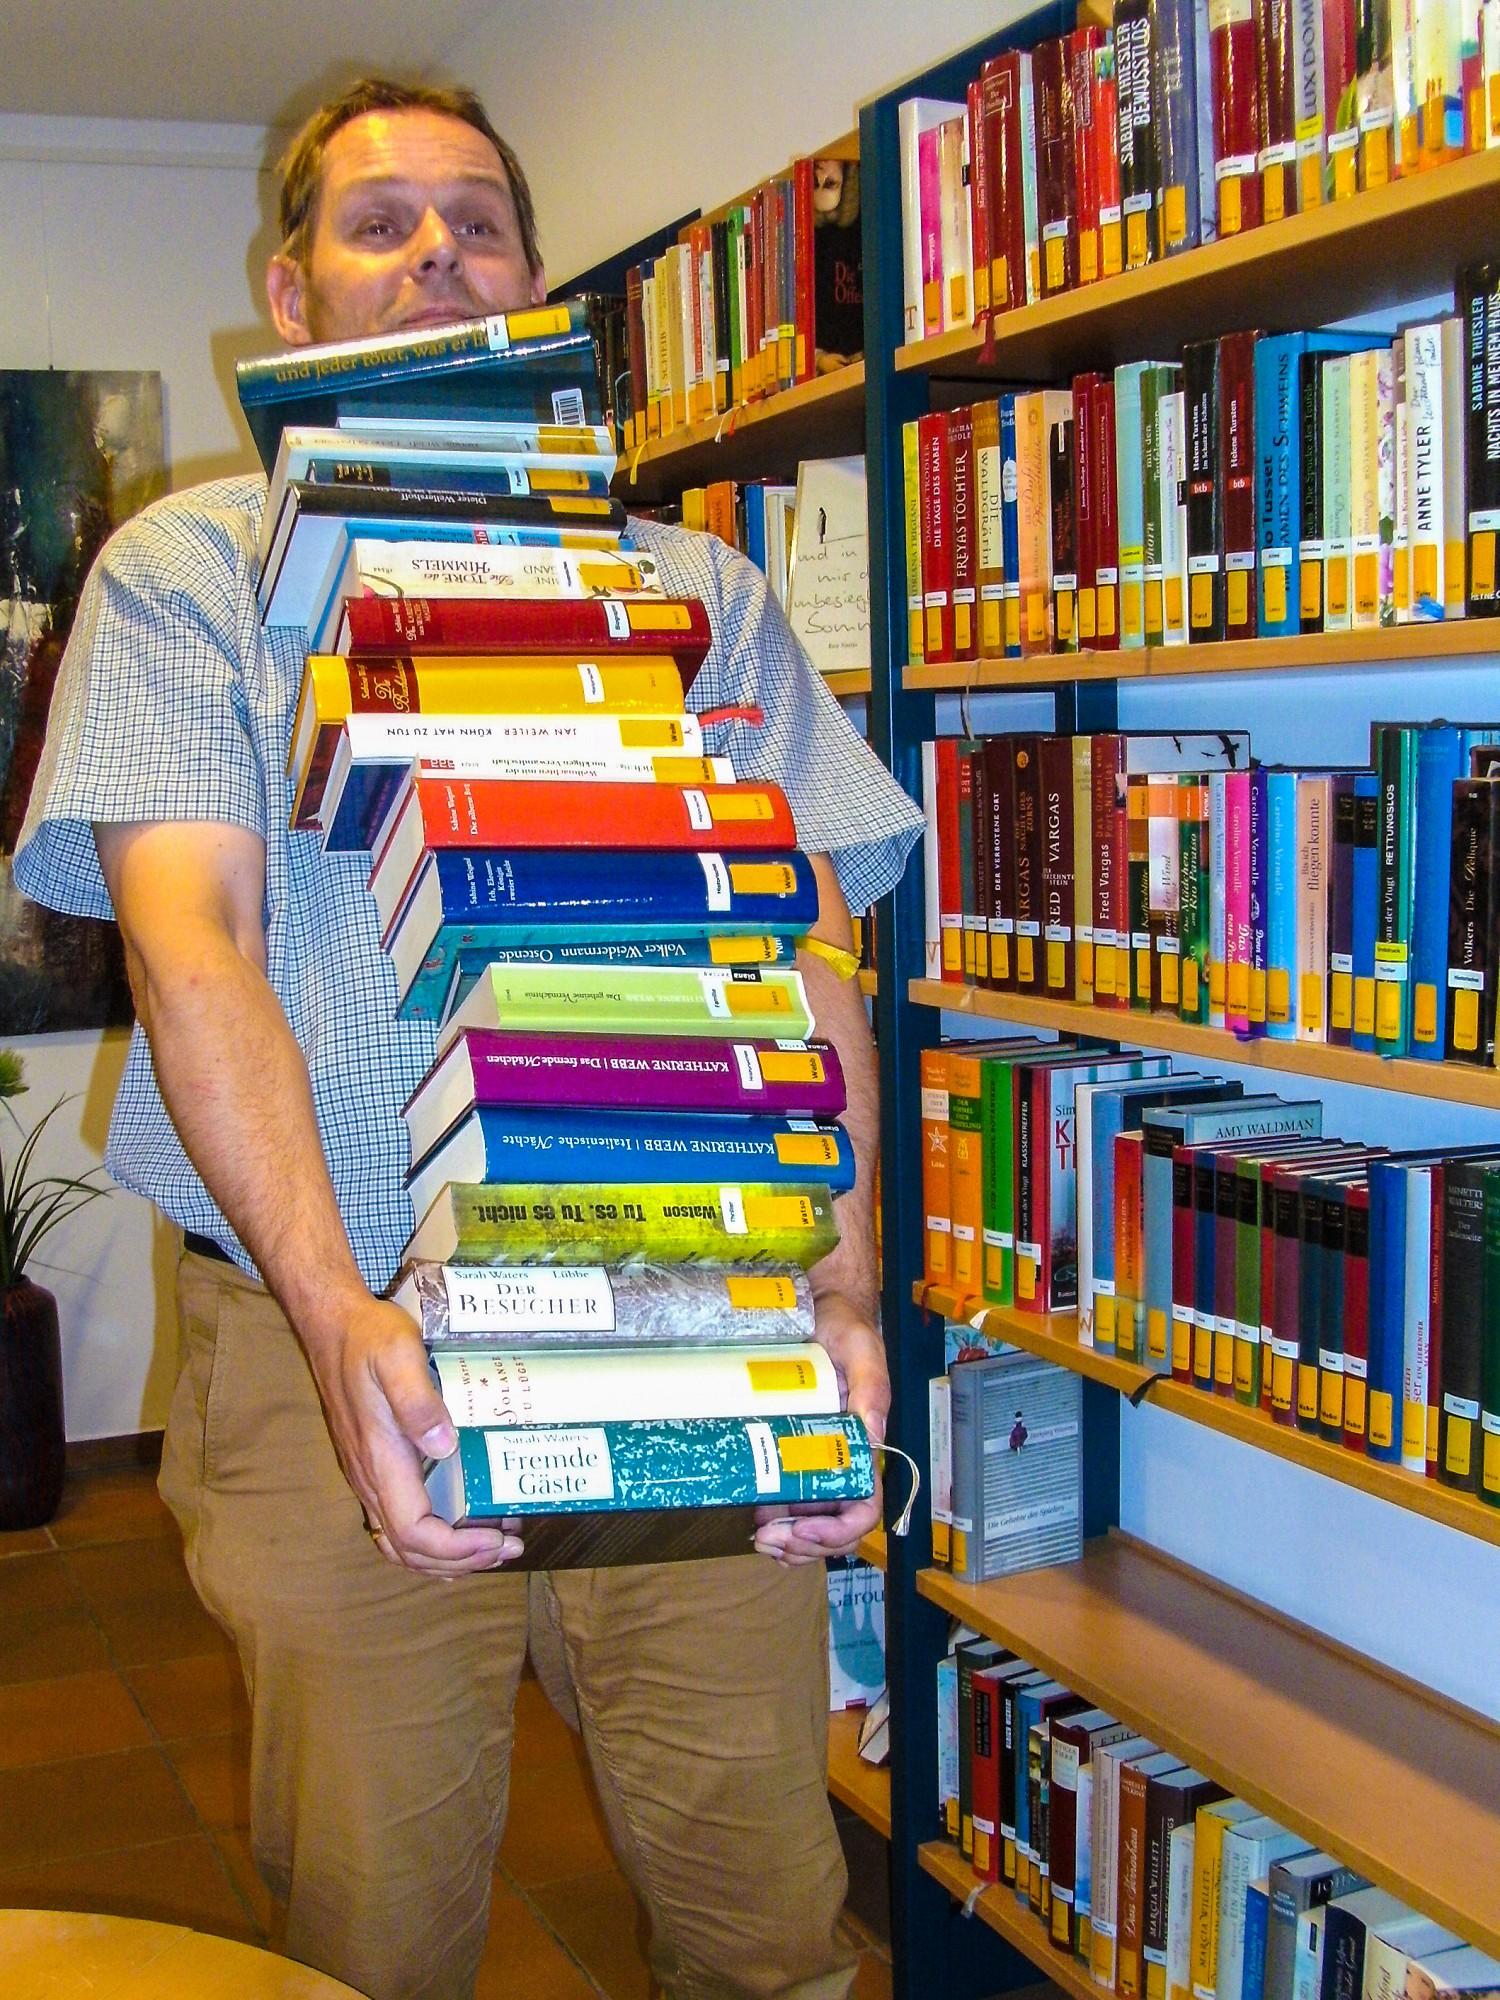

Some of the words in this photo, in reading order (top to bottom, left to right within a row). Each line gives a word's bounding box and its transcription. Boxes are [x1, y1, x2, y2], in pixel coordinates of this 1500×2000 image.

[1116, 23, 1132, 97] THIESLER
[1130, 18, 1152, 126] BEWUSSTLOS
[1305, 72, 1317, 121] LUX
[1119, 106, 1134, 165] SABINE
[1487, 294, 1500, 328] HAUS
[1472, 296, 1484, 359] THIESLER
[275, 363, 311, 383] und
[314, 358, 356, 381] jeder
[414, 339, 446, 359] was
[450, 336, 468, 352] er
[1487, 330, 1500, 386] MEINEM
[1472, 362, 1484, 411] SABINE
[1488, 389, 1500, 404] IN
[1273, 352, 1289, 447] SCHWEINS
[1229, 400, 1237, 434] Tursten
[1487, 408, 1500, 459] NACHTS
[931, 436, 940, 472] RABEN
[1145, 451, 1153, 468] mit
[1192, 440, 1200, 471] Helene
[1230, 436, 1238, 468] Helene
[1416, 425, 1431, 480] TYLER
[1278, 452, 1289, 486] DES
[932, 474, 940, 496] DES
[953, 450, 967, 523] TÖCHTER
[1263, 455, 1274, 526] Tusset
[400, 493, 455, 503] Wellershoff
[457, 495, 487, 505] Dieter
[981, 451, 990, 566] WALDGRÄFIN
[989, 494, 999, 520] DIE
[1417, 486, 1432, 531] ANNE
[910, 499, 918, 548] TRIGIANI
[933, 499, 941, 525] TAGE
[934, 528, 942, 548] DIE
[842, 545, 856, 557] in
[955, 526, 968, 577] FREYAS
[411, 559, 490, 573] HIMMELS
[442, 573, 486, 584] TORE
[387, 727, 410, 736] TUN
[412, 728, 428, 736] ZU
[433, 727, 454, 736] HAT
[460, 728, 491, 738] KÜHN
[504, 727, 549, 736] WEILER
[554, 728, 576, 736] JAN
[521, 768, 537, 776] mit
[539, 768, 597, 777] Weihnachten
[1251, 786, 1259, 835] Caroline
[1274, 796, 1282, 844] Caroline
[1309, 798, 1320, 844] konnte
[470, 822, 479, 835] Die
[1048, 793, 1060, 862] VARGAS
[1233, 806, 1242, 848] Caroline
[1386, 784, 1394, 865] RETTUNGSLOS
[1100, 844, 1111, 886] Vargas
[1464, 827, 1478, 882] Reliquie
[1233, 850, 1242, 895] Vermalle
[1309, 844, 1322, 890] fliegen
[469, 881, 477, 904] Sabine
[1385, 876, 1394, 903] Vlugt
[1465, 890, 1475, 911] Die
[1049, 892, 1061, 927] RED
[1099, 892, 1109, 919] Fred
[1384, 906, 1393, 922] der
[1238, 924, 1249, 951] Das
[1256, 929, 1264, 953] Denn
[1464, 921, 1475, 964] Volkers
[499, 949, 553, 963] Ostende
[561, 945, 643, 959] Weidermann
[644, 943, 686, 956] Volker
[733, 972, 756, 981] Diana
[524, 991, 576, 1003] Vermächtnis
[606, 993, 621, 1001] Das
[486, 1055, 541, 1067] Mädchen
[541, 1057, 578, 1068] fremde
[580, 1058, 601, 1069] Das
[610, 1058, 650, 1070] WEBB
[652, 1059, 729, 1072] KATHERINE
[1215, 1123, 1245, 1139] AMY
[1246, 1117, 1315, 1137] WALDMAN
[502, 1135, 554, 1150] Nächte
[558, 1136, 631, 1150] Italienische
[644, 1139, 687, 1151] WEBB
[690, 1140, 775, 1154] KATHERINE
[473, 1204, 527, 1223] nicht.
[542, 1205, 561, 1221] es
[561, 1206, 585, 1222] Tu
[589, 1204, 618, 1220] es.
[629, 1204, 646, 1222] Tu
[663, 1205, 717, 1220] Watson
[497, 1282, 536, 1295] DER
[459, 1294, 597, 1315] BESUCHER
[504, 1446, 598, 1472] Fremde
[836, 1439, 845, 1466] Water
[519, 1473, 586, 1496] Gäste
[828, 1588, 884, 1608] Garou
[1150, 1840, 1159, 1888] WILLETT
[1200, 1868, 1211, 1919] WILLETT
[1150, 1892, 1159, 1937] MARCIA
[1231, 1900, 1240, 1919] EIN
[1199, 1923, 1210, 1968] MARCIA
